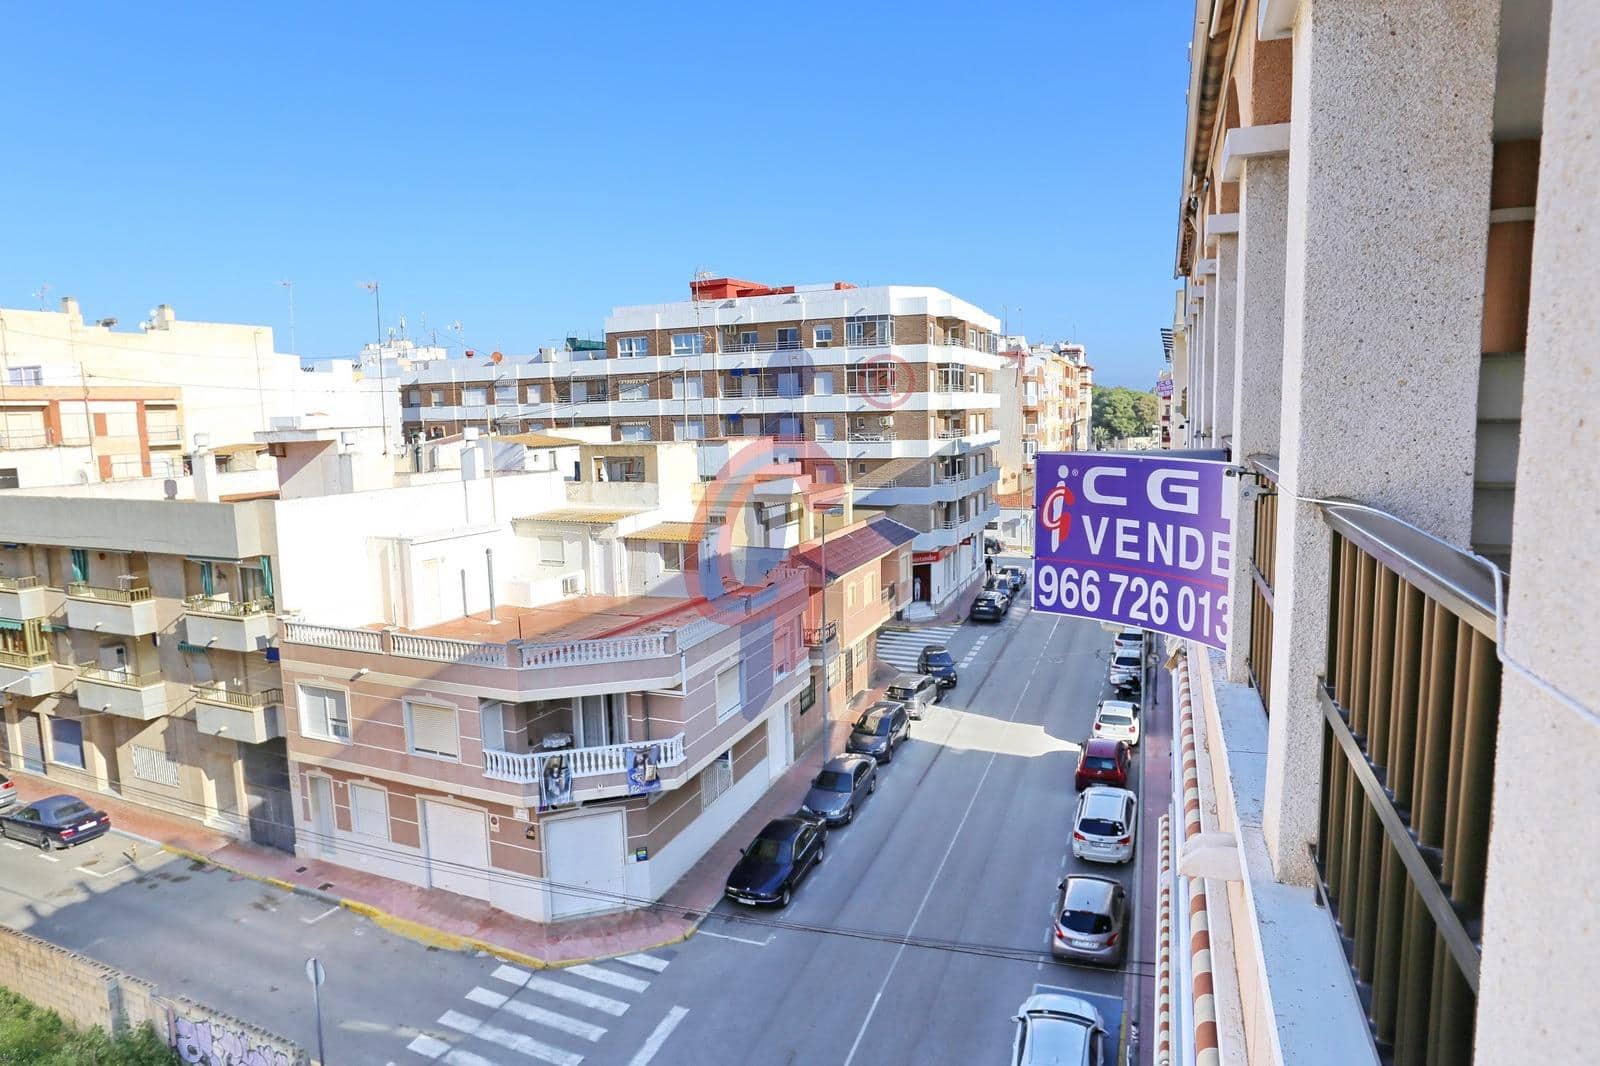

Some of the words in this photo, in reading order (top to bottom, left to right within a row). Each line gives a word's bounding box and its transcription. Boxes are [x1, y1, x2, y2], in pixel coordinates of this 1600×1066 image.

[1081, 514, 1231, 578] VENDE
[1038, 565, 1100, 612] 966
[1109, 573, 1169, 626] 726
[1177, 585, 1231, 645] 013
